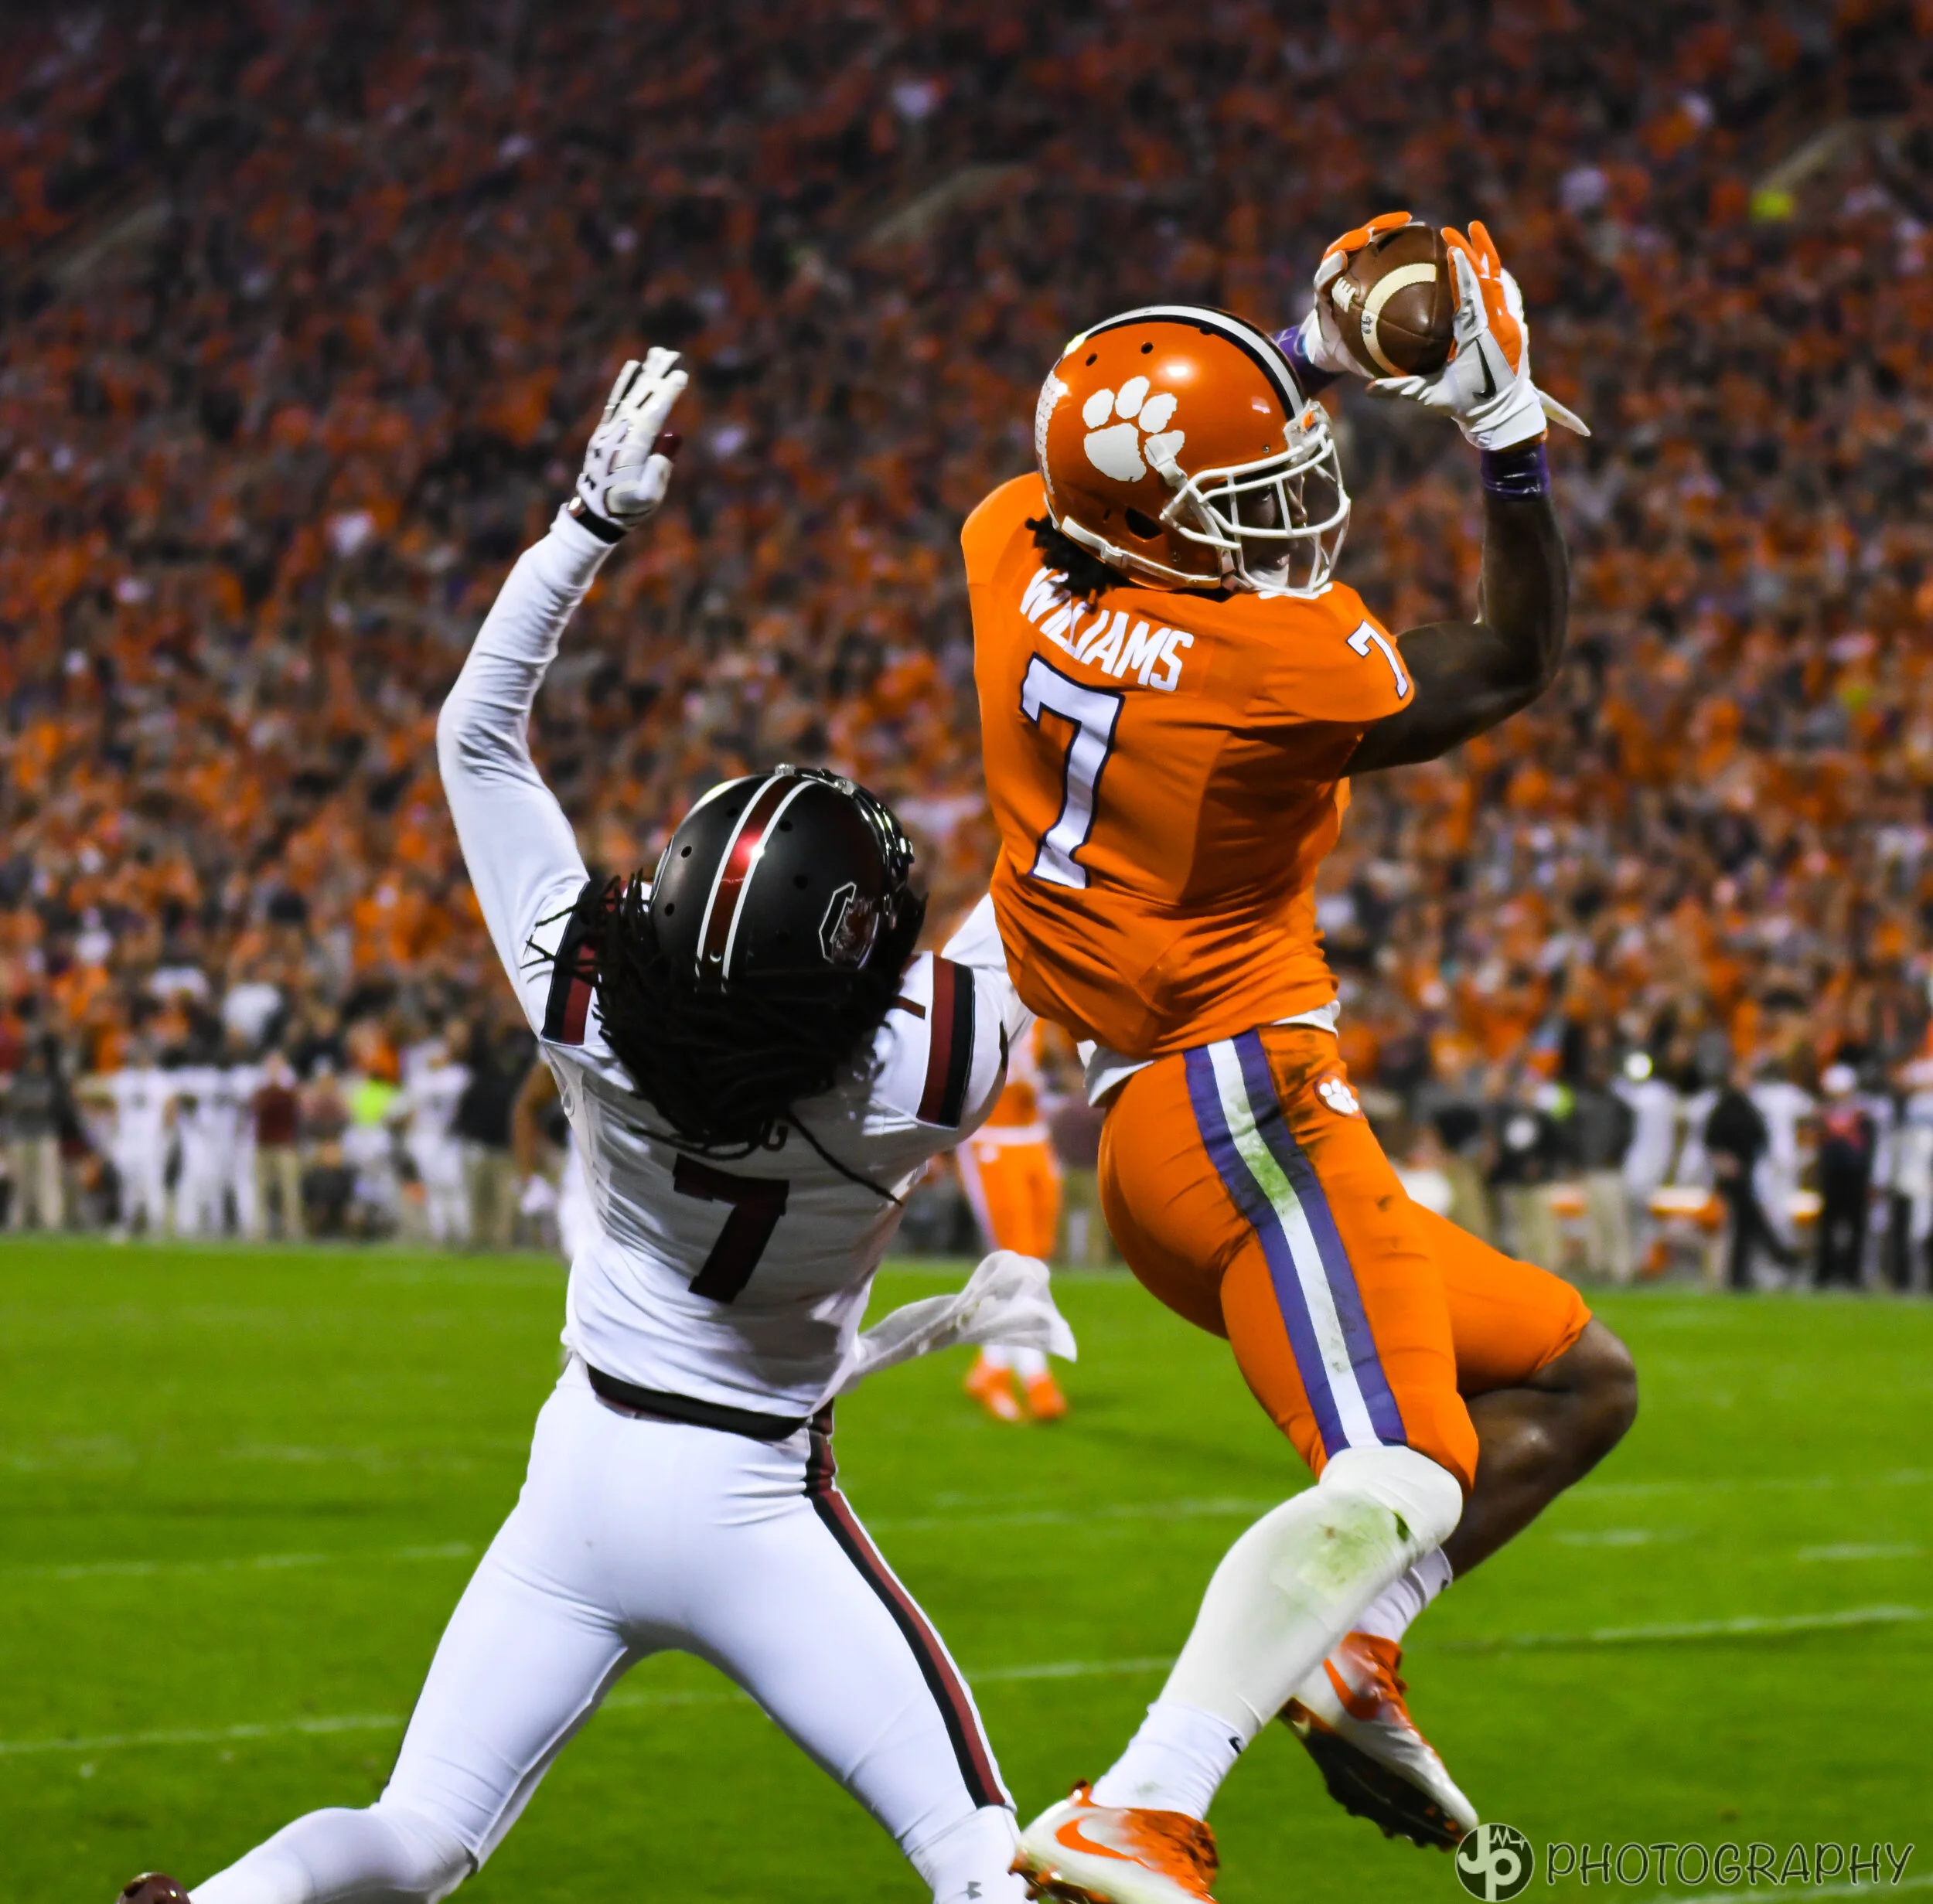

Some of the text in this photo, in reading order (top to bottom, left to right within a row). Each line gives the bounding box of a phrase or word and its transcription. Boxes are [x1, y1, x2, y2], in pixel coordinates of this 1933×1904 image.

[1019, 566, 1195, 692] WILLIAMS
[1346, 618, 1409, 700] 7
[1019, 652, 1125, 890] 7
[673, 1153, 790, 1305] 7
